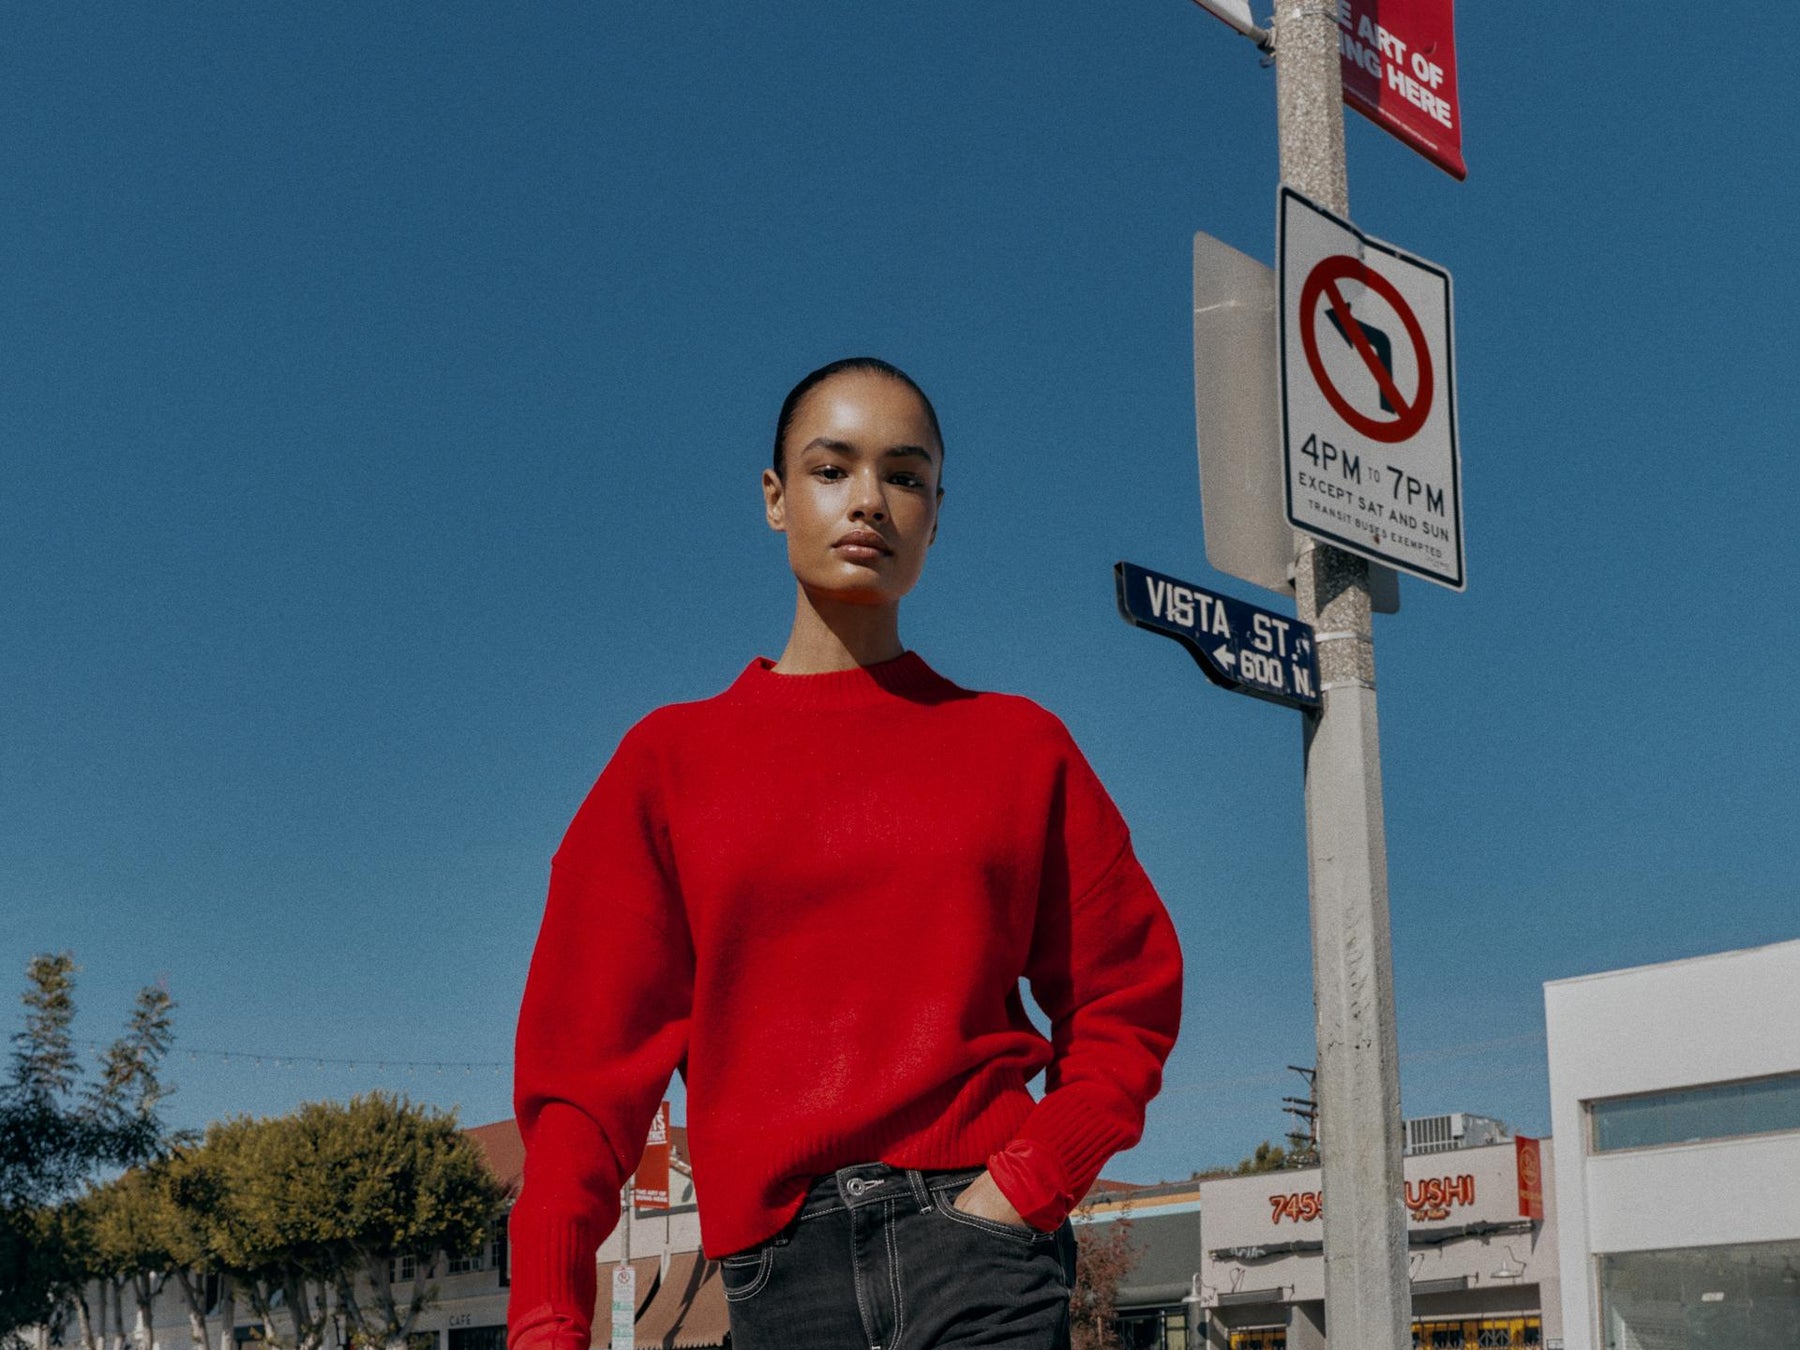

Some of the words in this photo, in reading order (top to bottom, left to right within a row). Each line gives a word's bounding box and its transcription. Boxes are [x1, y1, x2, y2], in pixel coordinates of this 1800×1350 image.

[1338, 30, 1383, 79] ING
[1386, 63, 1453, 129] HERE
[1357, 14, 1407, 66] ART
[1411, 52, 1444, 89] OF
[1298, 472, 1353, 505] EXCEPT
[1358, 496, 1384, 517] SAT
[1389, 509, 1417, 530] AND
[1422, 521, 1449, 542] SUN
[1301, 433, 1361, 485] 4PM
[1367, 467, 1380, 483] TO
[1386, 465, 1445, 517] 7PM
[1308, 499, 1351, 523] TRANSIT
[1355, 518, 1387, 539] BUSES
[1391, 532, 1442, 558] EXEMPTED
[1145, 575, 1231, 639] VISTA
[1240, 649, 1284, 689] 600
[1269, 1191, 1322, 1225] 745
[1404, 1174, 1475, 1211] USHI
